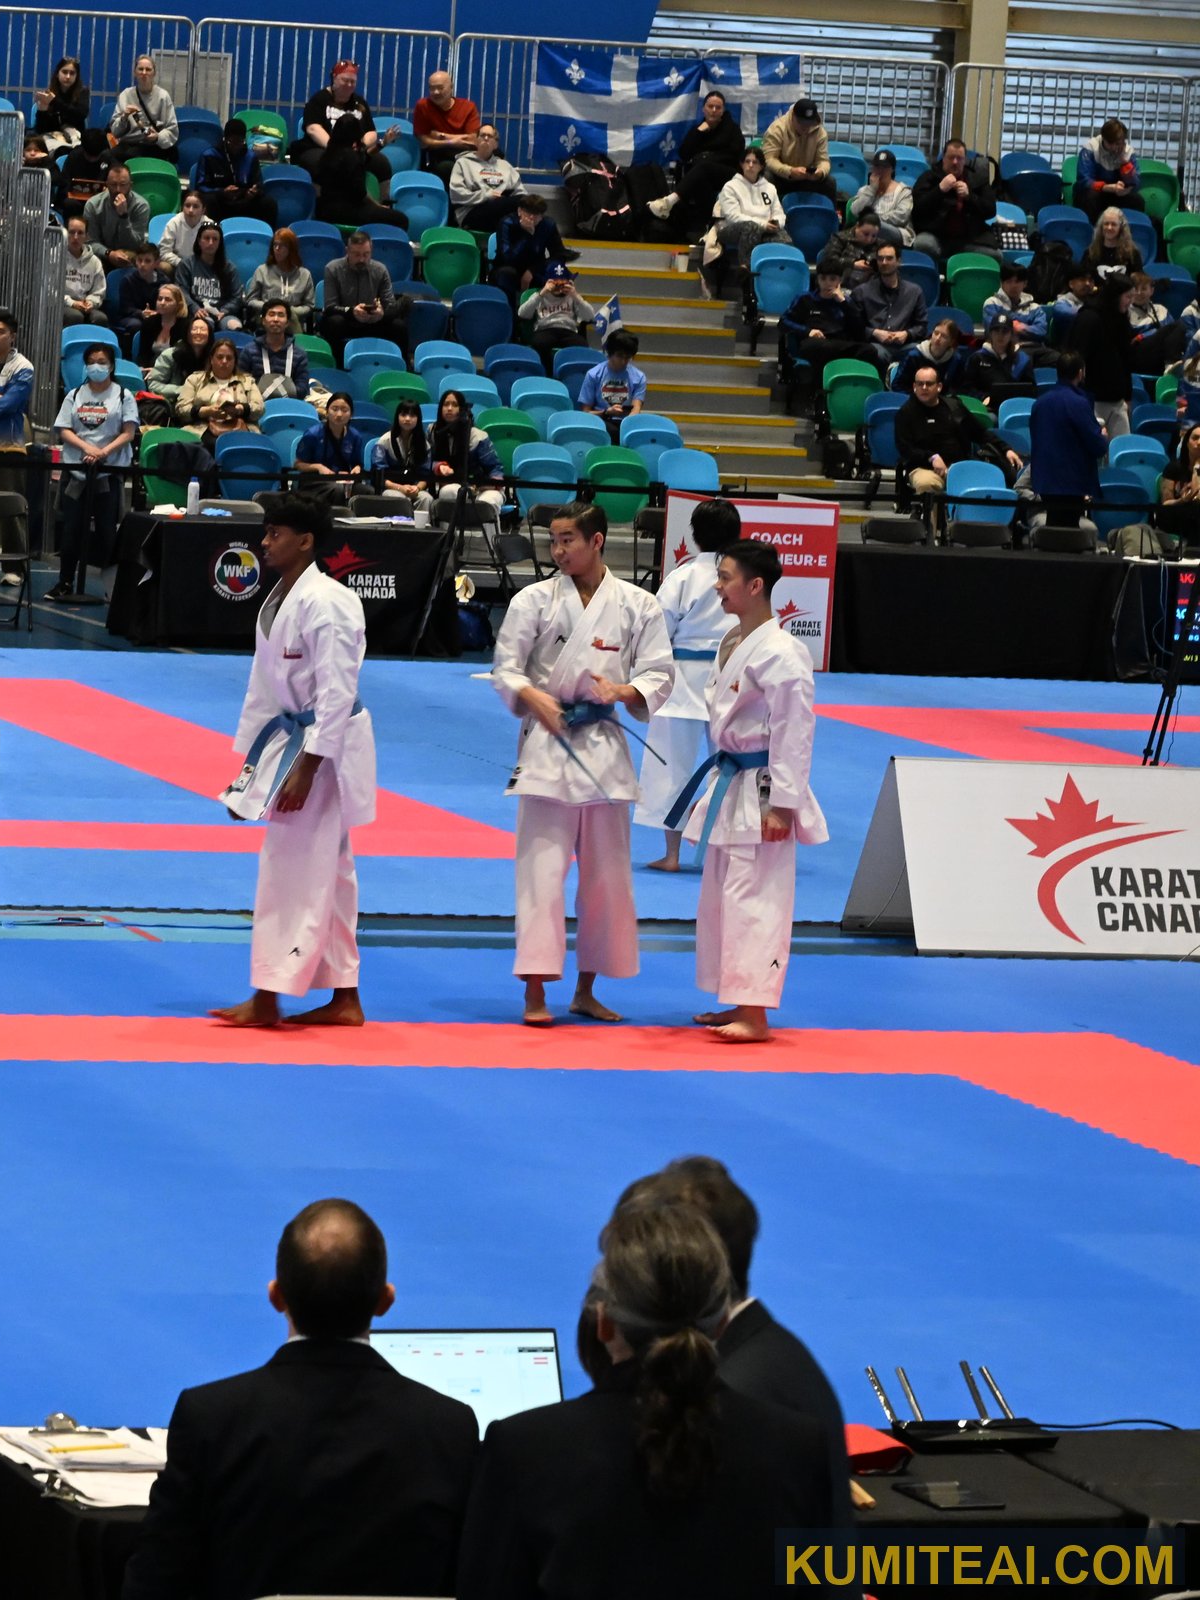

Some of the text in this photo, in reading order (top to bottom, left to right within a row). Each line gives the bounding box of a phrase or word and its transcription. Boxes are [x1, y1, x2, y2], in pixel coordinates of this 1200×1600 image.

[761, 191, 772, 205] B
[223, 564, 251, 578] WKF
[347, 574, 396, 587] KARATE
[350, 586, 397, 599] ANADA
[791, 620, 822, 630] KARATE
[790, 629, 821, 637] CANADA
[1091, 866, 1200, 899] KARAT
[1097, 901, 1200, 934] CANA
